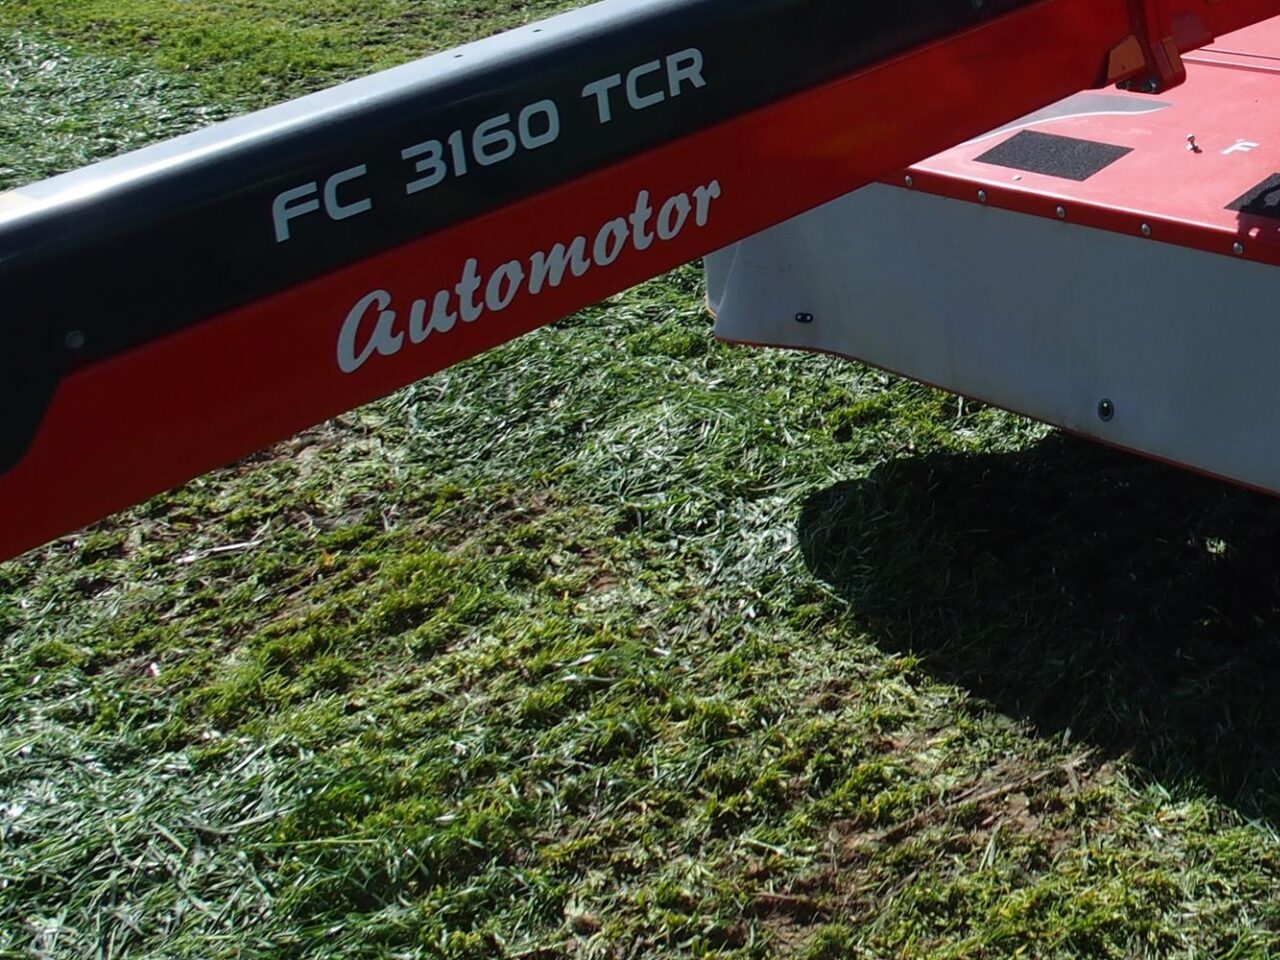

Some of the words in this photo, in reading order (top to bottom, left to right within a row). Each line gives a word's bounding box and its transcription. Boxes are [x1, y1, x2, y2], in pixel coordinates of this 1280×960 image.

[271, 163, 372, 243] FC
[401, 98, 561, 195] 3160
[581, 47, 707, 124] TCR
[336, 179, 722, 374] Automotor
